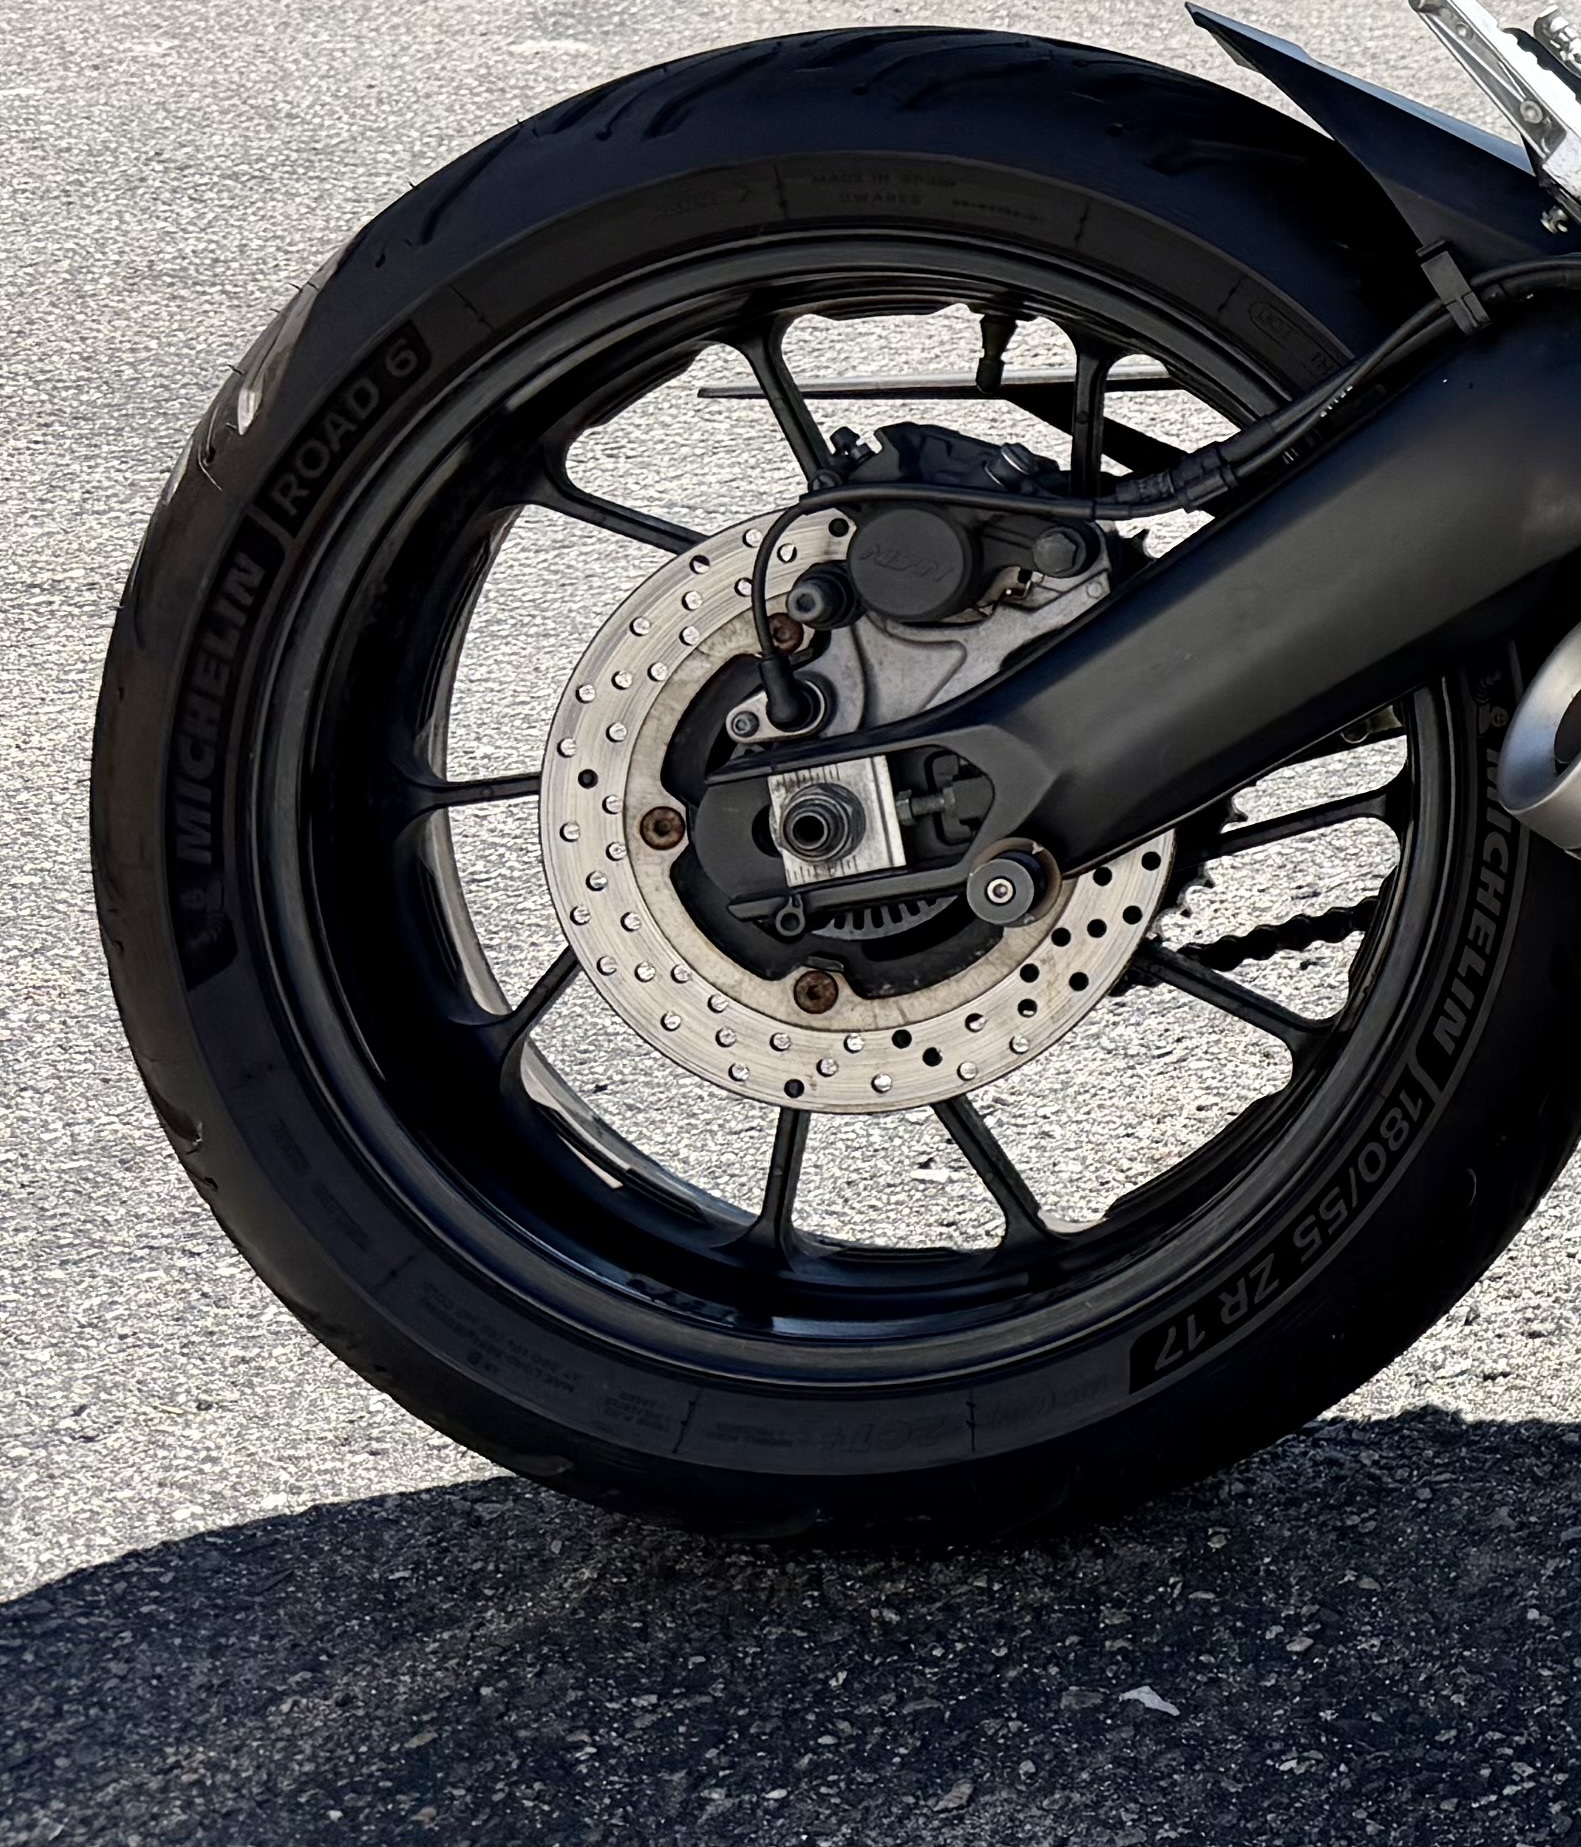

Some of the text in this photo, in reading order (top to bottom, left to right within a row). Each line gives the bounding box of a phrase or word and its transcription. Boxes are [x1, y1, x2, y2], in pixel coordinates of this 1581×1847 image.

[174, 339, 418, 867] MICHELIN ROAD 6
[1153, 748, 1515, 1374] MICHELIN 180/55 ZR 17
